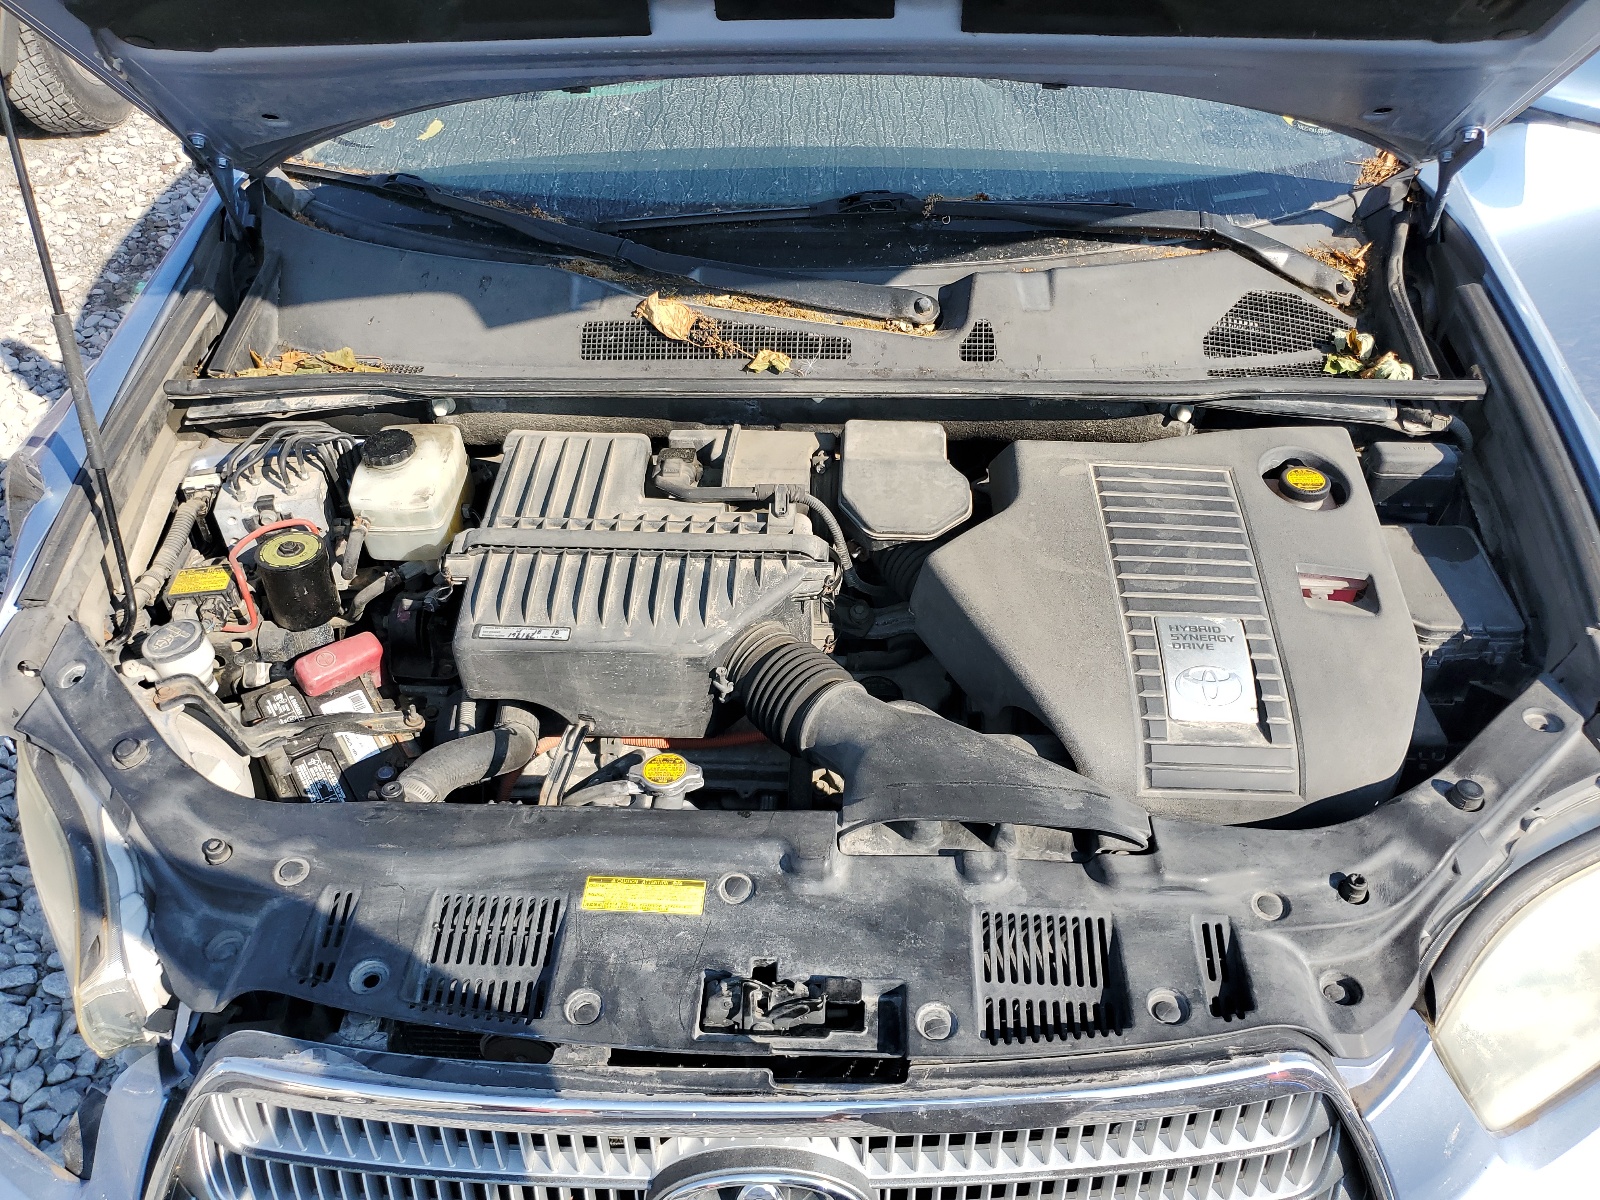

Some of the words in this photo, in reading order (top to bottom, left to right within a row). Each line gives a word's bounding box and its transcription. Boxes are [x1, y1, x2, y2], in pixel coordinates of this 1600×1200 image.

[1168, 625, 1221, 633] HYBRID
[1170, 634, 1235, 642] SYNERGY
[1172, 642, 1215, 650] DRIVE
